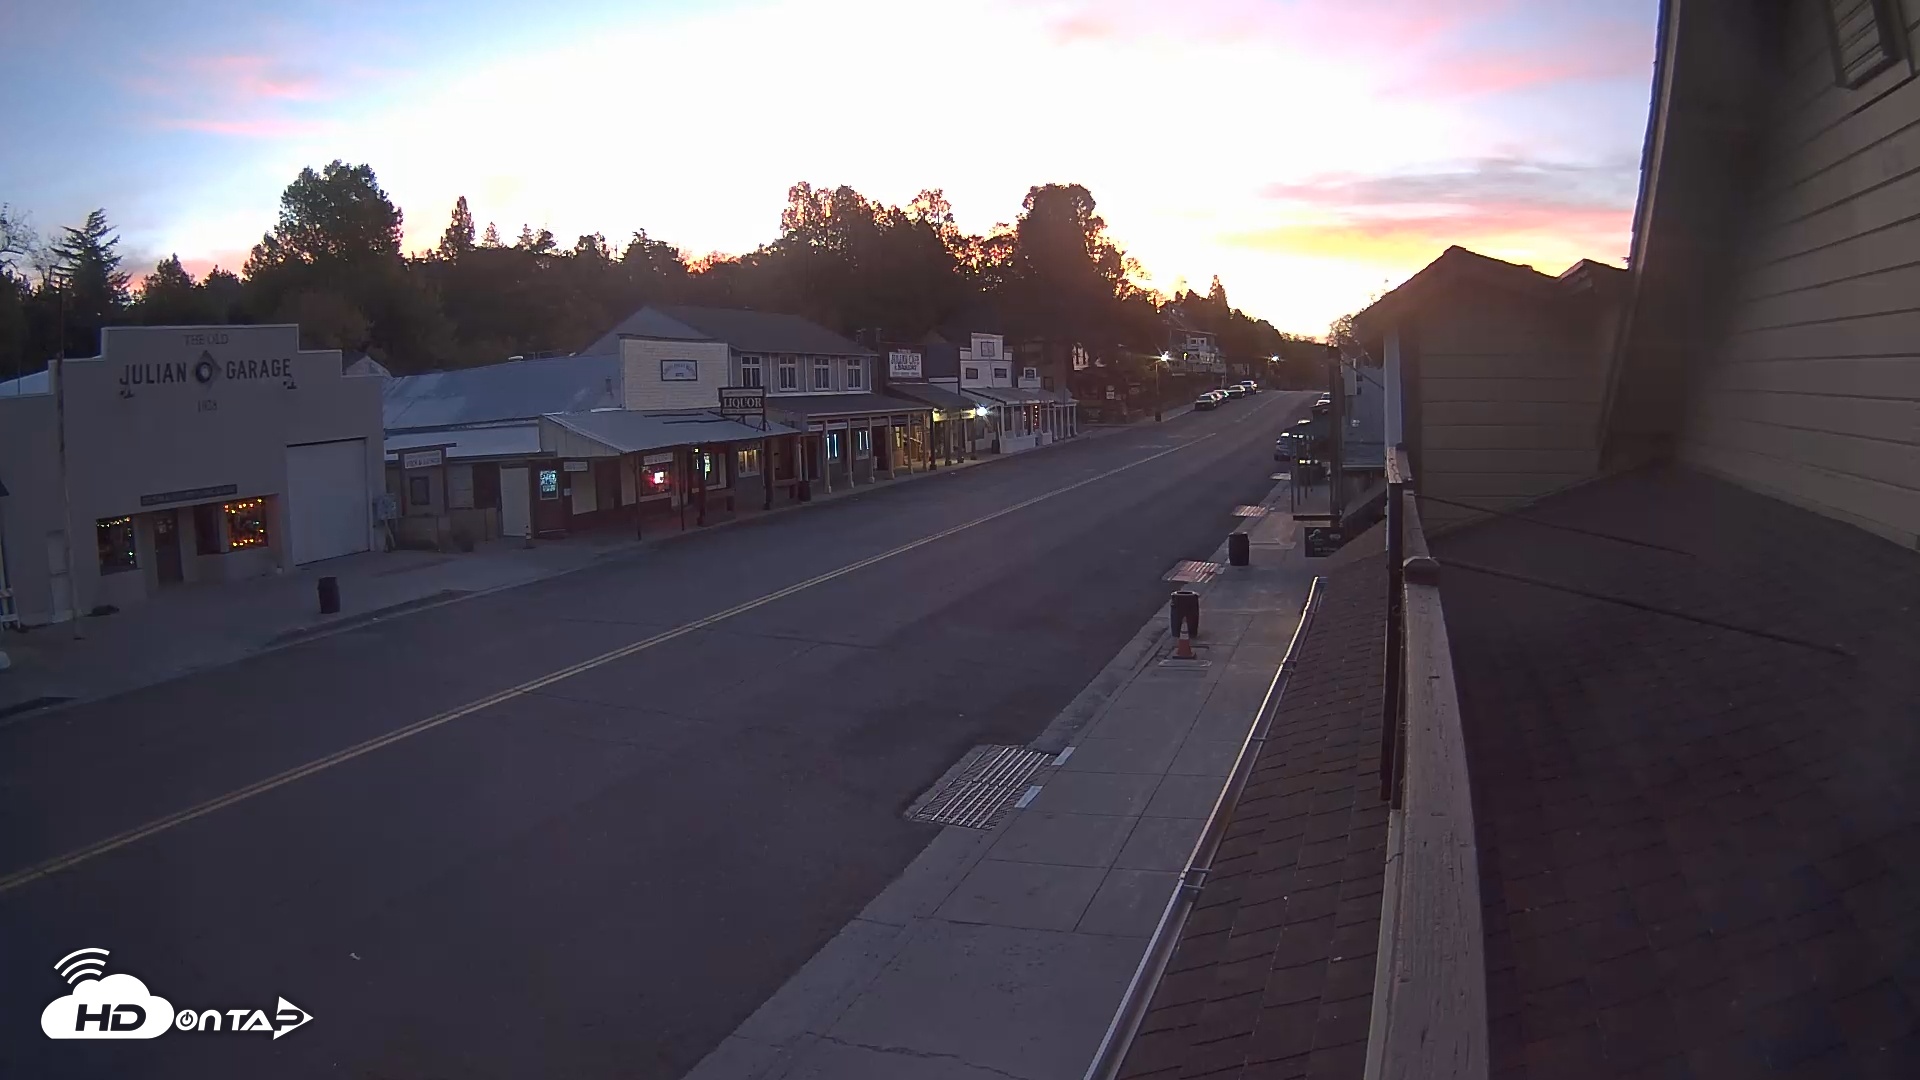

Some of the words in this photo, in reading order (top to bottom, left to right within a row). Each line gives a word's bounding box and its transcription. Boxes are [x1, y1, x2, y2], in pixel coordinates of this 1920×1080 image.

[183, 334, 205, 346] THE
[207, 333, 229, 345] OLD
[119, 362, 187, 385] JULIAN
[226, 358, 291, 380] GARAGE
[723, 397, 762, 409] LIQUOR
